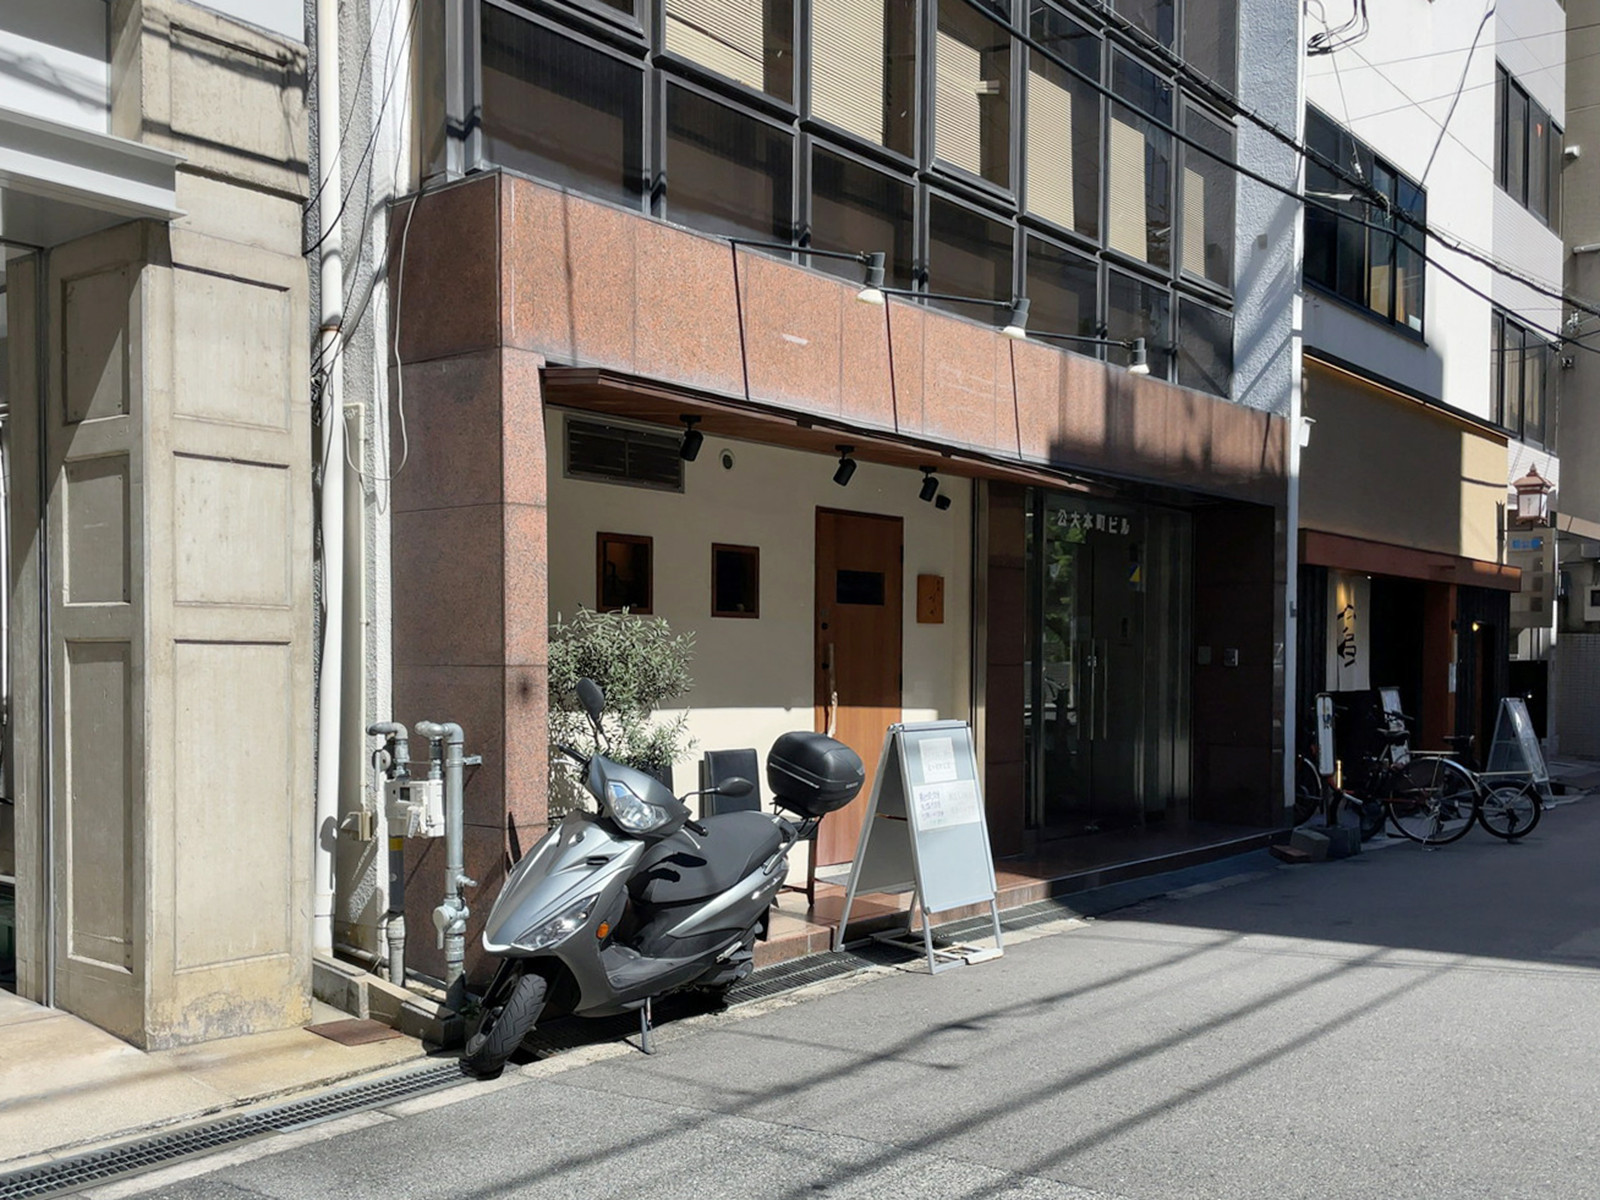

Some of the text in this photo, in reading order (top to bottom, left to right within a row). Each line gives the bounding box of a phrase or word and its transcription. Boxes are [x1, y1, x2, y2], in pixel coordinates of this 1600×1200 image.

[1057, 508, 1130, 535] 公大本町ビル
